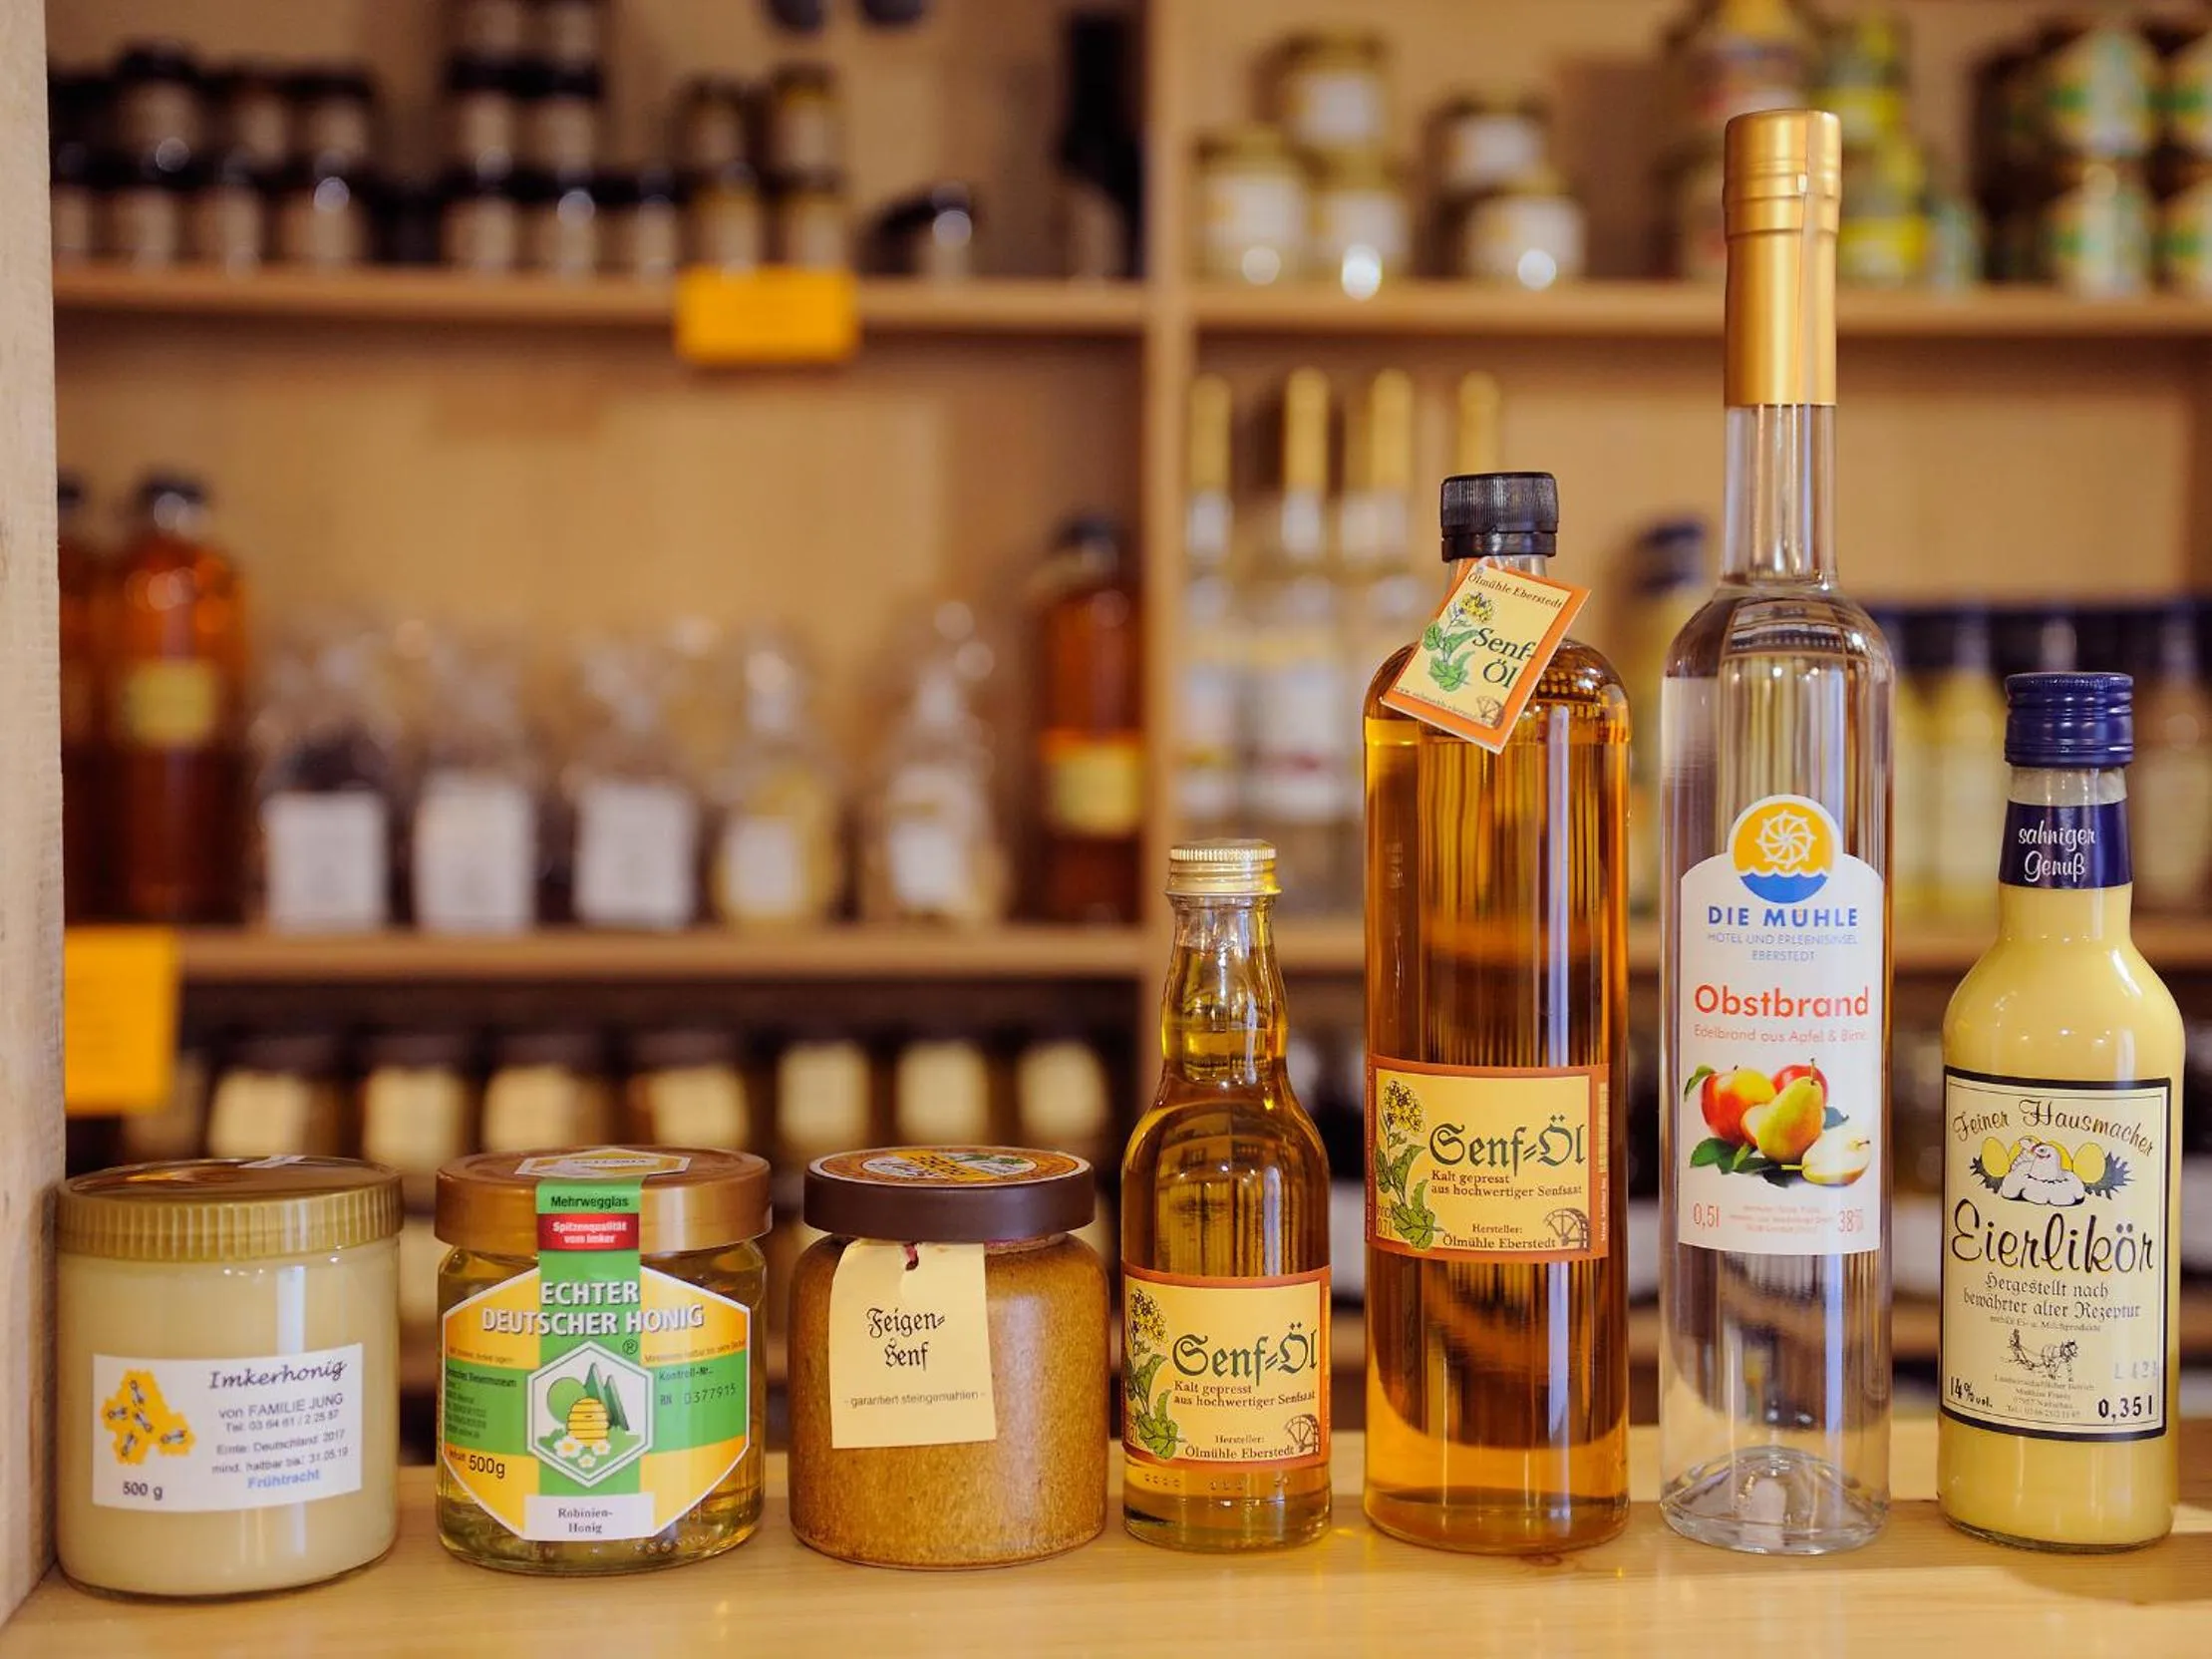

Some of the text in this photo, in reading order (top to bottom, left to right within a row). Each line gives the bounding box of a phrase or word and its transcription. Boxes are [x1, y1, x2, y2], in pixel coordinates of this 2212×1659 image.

[1472, 627, 1537, 662] Senf-
[1482, 658, 1519, 690] Öl
[2019, 821, 2096, 852] sahniger
[2025, 850, 2086, 882] Genuß
[1709, 906, 1749, 926] DIE
[1708, 932, 1742, 944] HOTEL
[1751, 949, 1815, 962] EBERSTEDT
[1695, 983, 1869, 1018] Obstbrand
[1953, 1099, 2153, 1157] Feiner Hausmacher
[1431, 1169, 1510, 1186] Kalt gepresst
[1430, 1184, 1450, 1194] aus
[1453, 1183, 1534, 1199] hochwertiger
[550, 1195, 630, 1209] Mehrwegglas
[1471, 1223, 1523, 1235] Hersteller:
[1952, 1198, 2153, 1273] Eierlikör
[1442, 1233, 1556, 1249] Ölmühle Eberstedt
[540, 1280, 640, 1305] ECHTER
[1985, 1271, 2110, 1299] Hergestellt nach
[1964, 1288, 2141, 1321] bewährter alter Rezeptur
[481, 1303, 705, 1337] DEUTSCHER HONIG
[883, 1337, 930, 1371] Senf
[209, 1360, 348, 1390] Imkerhonig
[1174, 1380, 1252, 1398] Kalt gepresst
[218, 1393, 344, 1419] von FAMILIE JUNG
[1173, 1396, 1193, 1406] aus
[1196, 1394, 1275, 1411] hochwertiger
[1214, 1434, 1265, 1445] Hersteller:
[1184, 1444, 1295, 1460] Ölmühle Eberstedt
[470, 1455, 505, 1480] 500g
[247, 1470, 320, 1490] Frühtracht
[123, 1482, 163, 1500] 500 g
[557, 1505, 614, 1520] Robinien-
[568, 1521, 603, 1535] Honig
